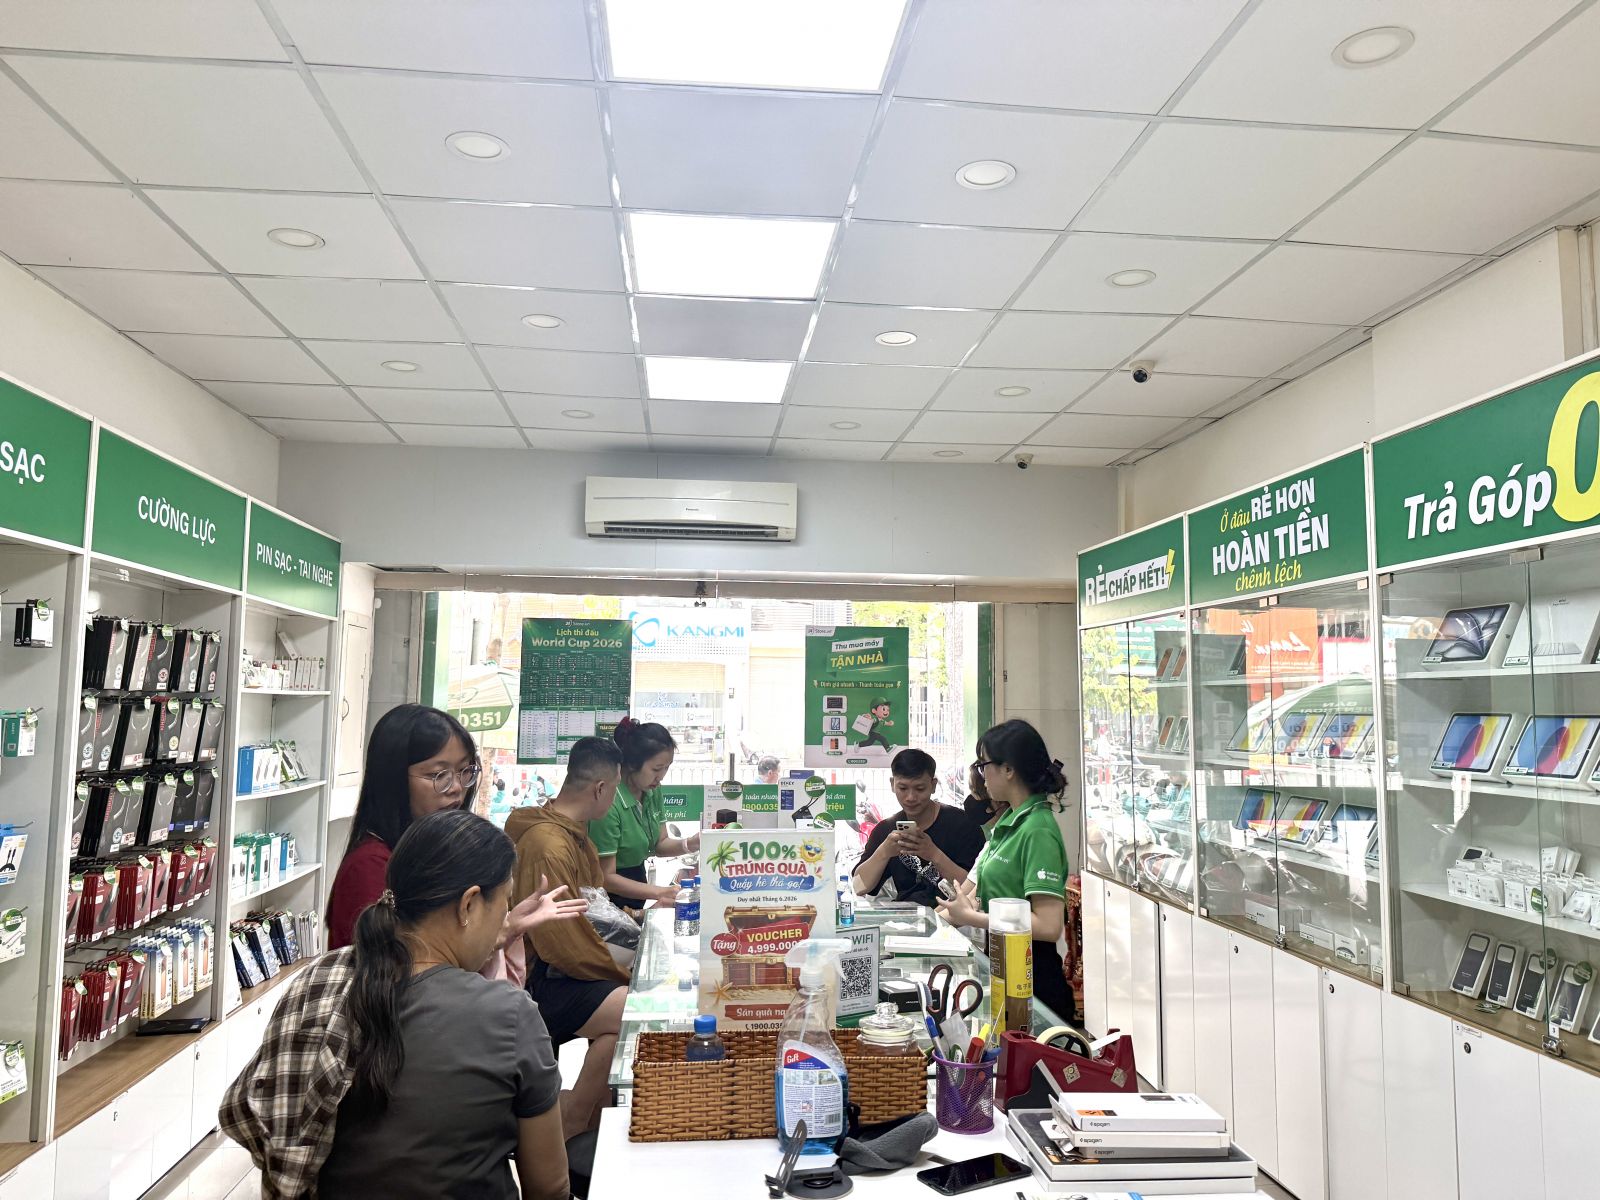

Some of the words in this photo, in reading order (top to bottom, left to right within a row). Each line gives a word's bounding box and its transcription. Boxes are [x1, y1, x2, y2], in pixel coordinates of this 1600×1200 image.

[0, 441, 46, 485] SẠC
[1251, 486, 1272, 522] RẺ
[1275, 477, 1315, 515] HƠN
[1404, 480, 1458, 540] Trả
[1468, 463, 1552, 528] Góp
[138, 495, 189, 535] CƯỜNG
[192, 516, 216, 546] LỰC
[1220, 508, 1229, 533] Ở
[1230, 508, 1251, 530] đâu
[1212, 529, 1270, 576] HOÀN
[1274, 506, 1330, 560] TIỀN
[256, 542, 273, 566] PIN
[274, 549, 293, 575] SẠC
[299, 559, 311, 578] TAI
[312, 566, 334, 588] NGHE
[1085, 564, 1107, 608] RẺ
[1108, 569, 1137, 598] CHẤP
[1138, 561, 1165, 591] HẾT!
[1235, 567, 1272, 592] chênh
[1275, 559, 1303, 588] lệch
[556, 629, 571, 637] Lịch
[573, 628, 584, 636] thi
[584, 628, 599, 636] đấu
[667, 625, 745, 638] KANGMI
[531, 637, 566, 648] World
[567, 638, 591, 650] Cup
[592, 638, 623, 648] 2026
[864, 640, 880, 648] máy
[830, 654, 855, 670] TẬN
[856, 650, 884, 665] NHÀ
[739, 841, 797, 860] 100%
[726, 861, 775, 876] TRÚNG
[777, 860, 808, 876] QUÀ
[747, 928, 803, 943] VOUCHER
[852, 933, 873, 945] WIFI
[713, 939, 737, 952] Tặng
[755, 1008, 773, 1018] quà
[787, 1054, 799, 1063] Gift
